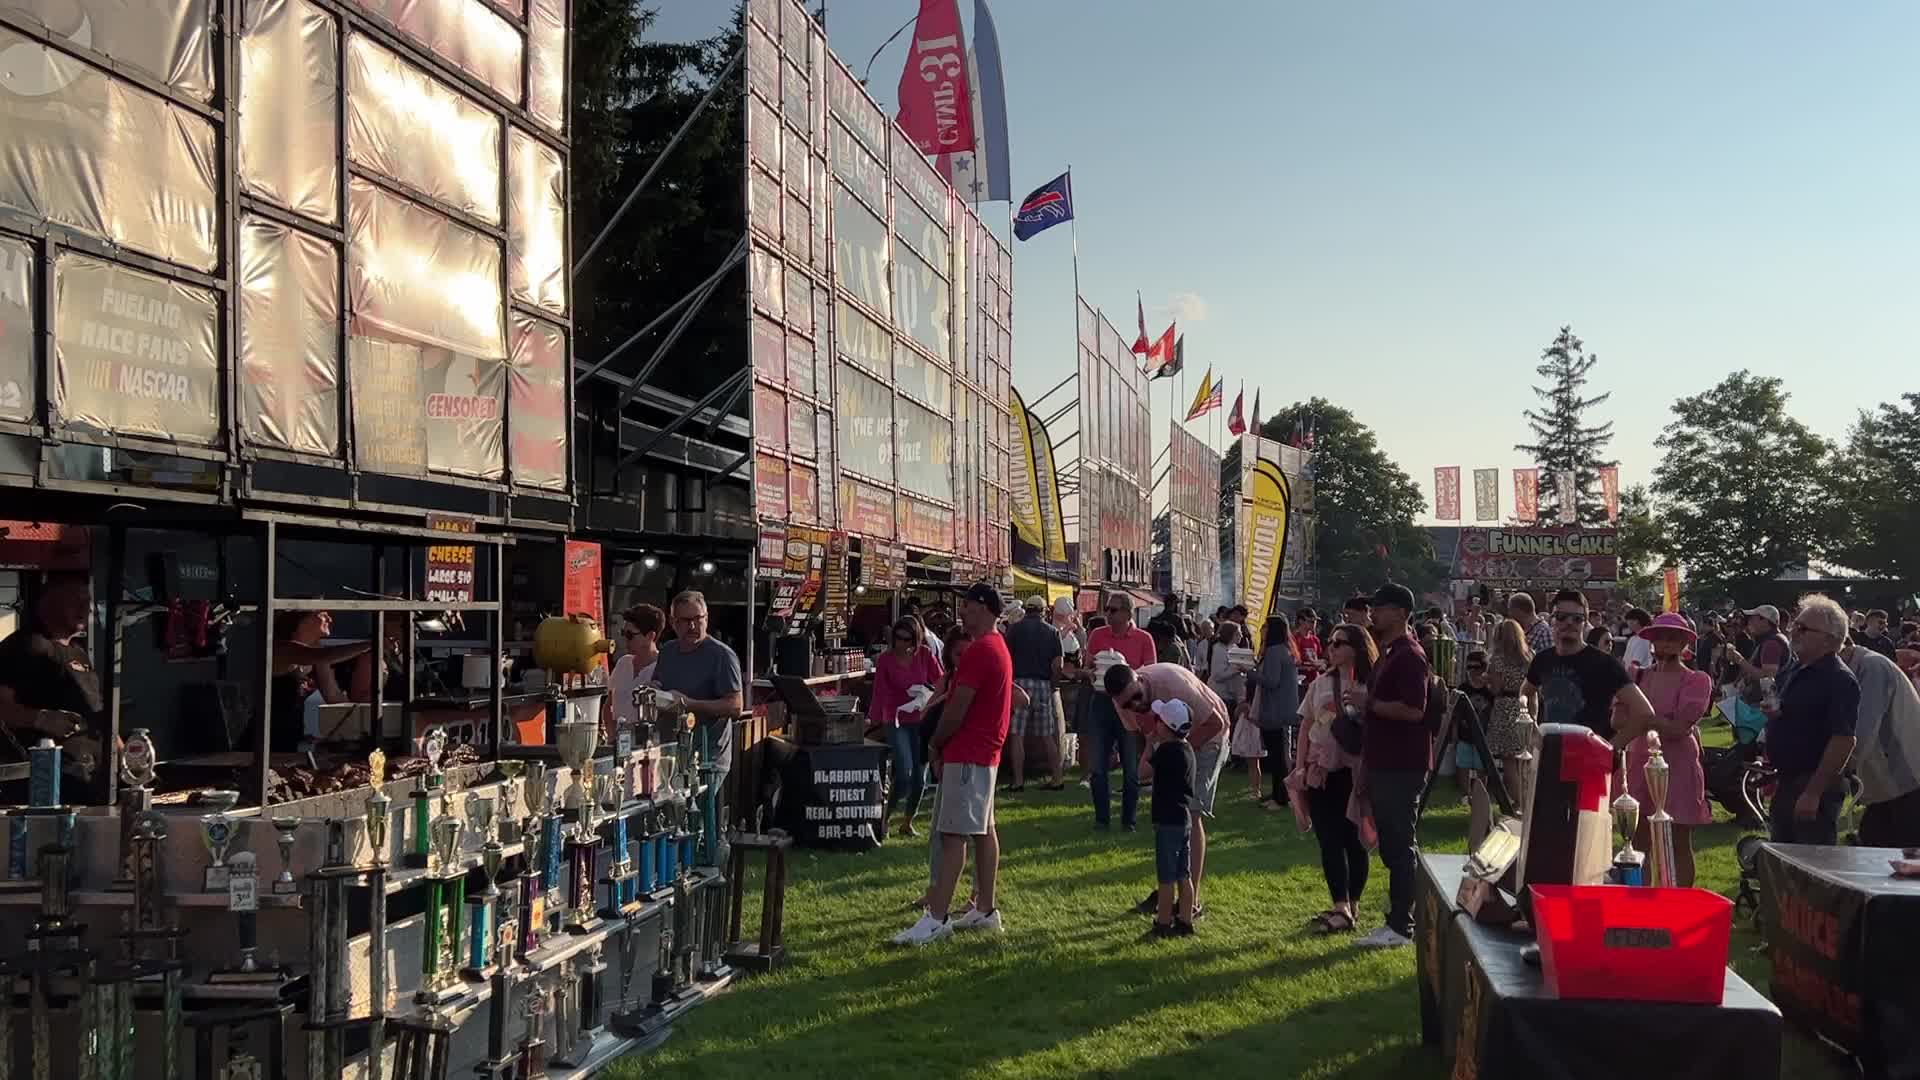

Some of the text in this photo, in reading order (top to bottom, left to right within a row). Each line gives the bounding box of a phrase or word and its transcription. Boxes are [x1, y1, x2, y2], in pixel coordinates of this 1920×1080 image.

[917, 34, 961, 83] 31
[102, 287, 181, 329] FUELING
[80, 319, 189, 366] RACE FANS
[119, 363, 190, 403] NASCAR
[427, 394, 497, 418] CENSORED
[853, 416, 909, 437] THE HERT
[1488, 530, 1616, 556] FUNNEL CAKE
[428, 546, 474, 563] CHEESE
[428, 569, 472, 585] LARGE $10
[427, 590, 457, 602] SMALL
[813, 769, 881, 785] ALABAMA'S
[829, 788, 867, 803] FINEST
[805, 806, 833, 820] REAL
